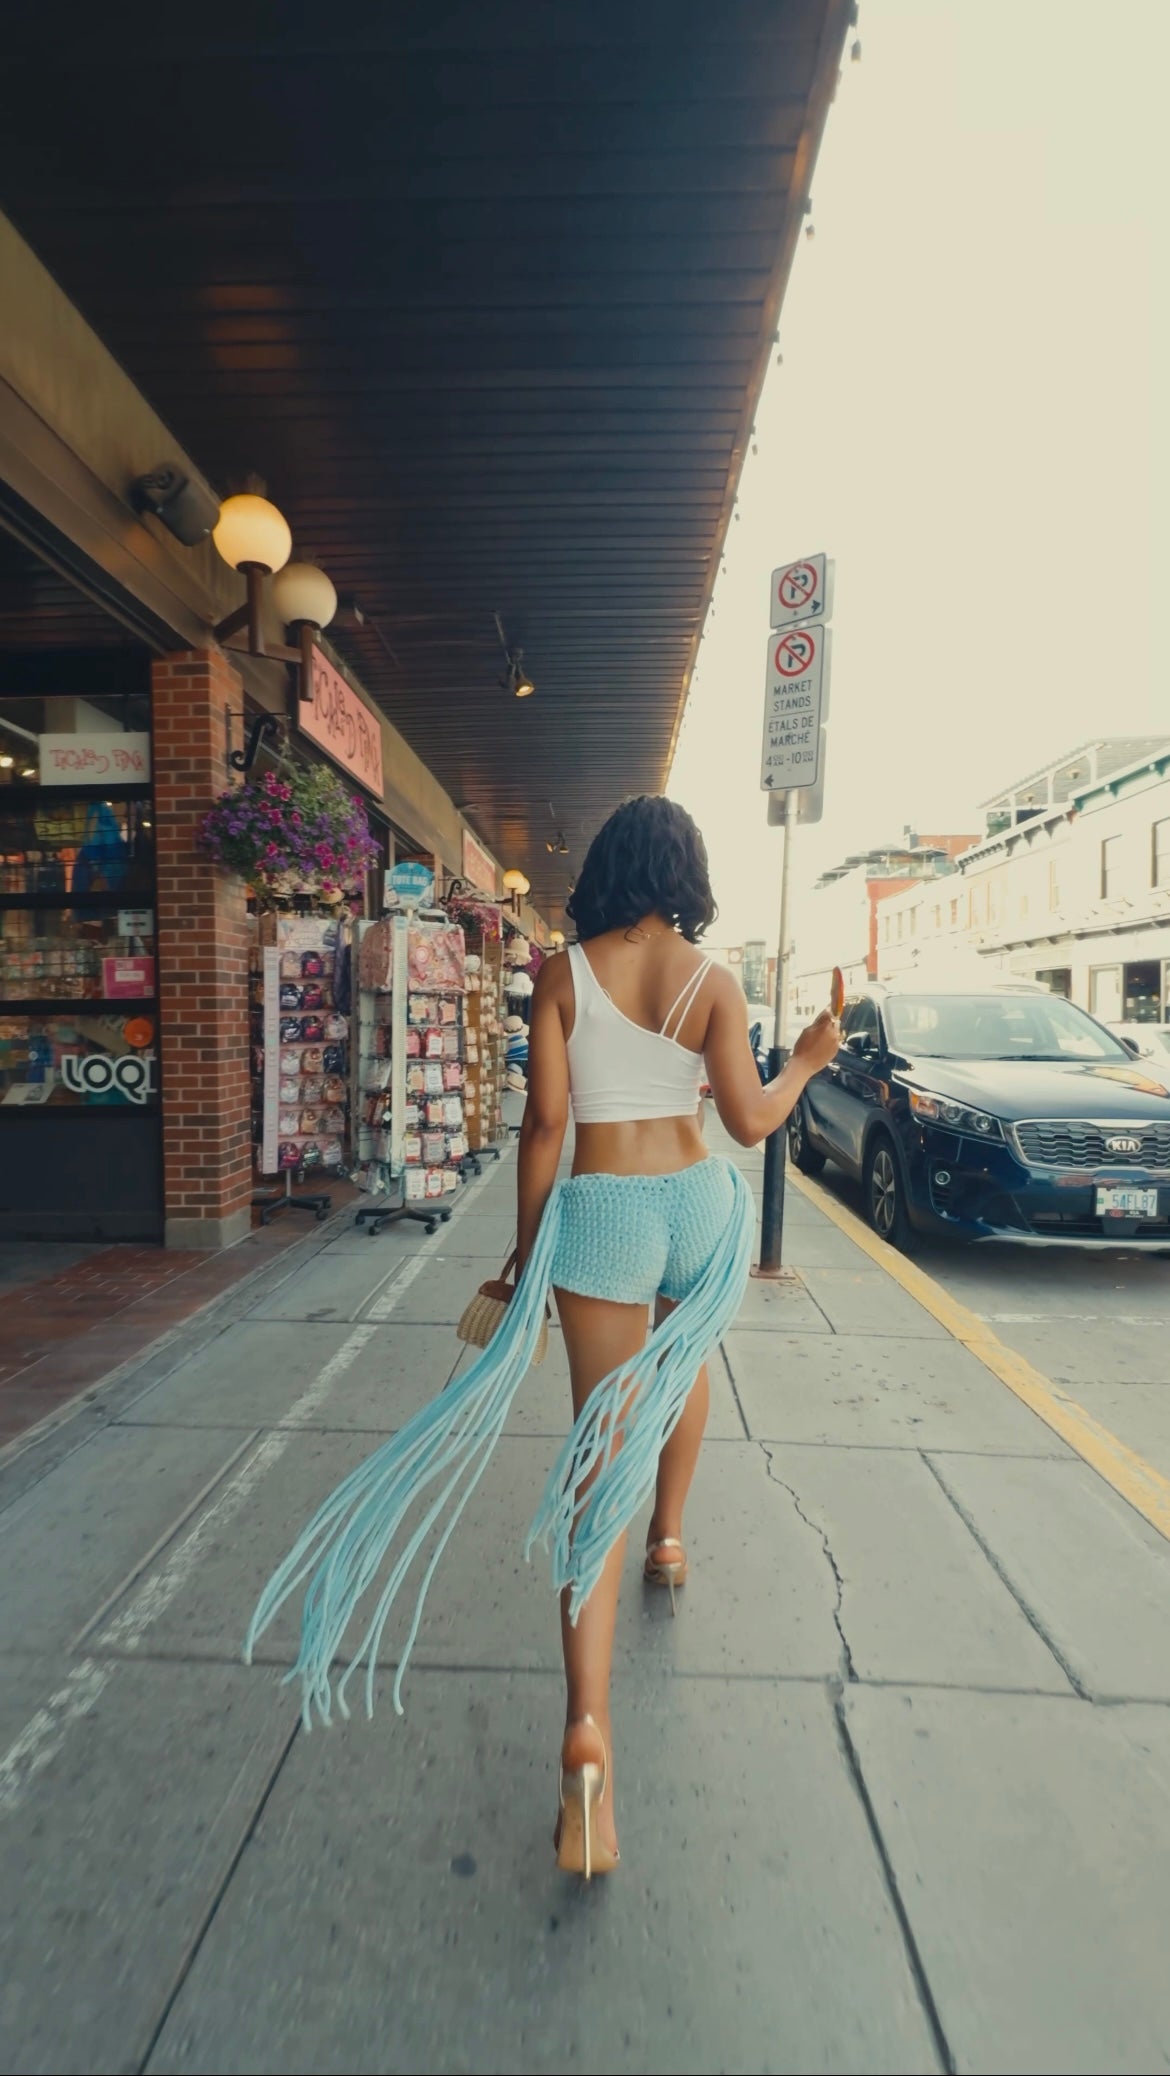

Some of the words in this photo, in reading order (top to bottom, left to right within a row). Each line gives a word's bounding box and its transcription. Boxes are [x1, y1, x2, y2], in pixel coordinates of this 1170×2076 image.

[773, 680, 812, 696] MARKET
[773, 696, 811, 712] STANDS
[768, 718, 799, 733] ÉTALS
[801, 716, 814, 728] DE
[770, 731, 810, 748] MARCHÉ
[392, 874, 410, 885] TOTE
[1111, 1140, 1136, 1151] KIA
